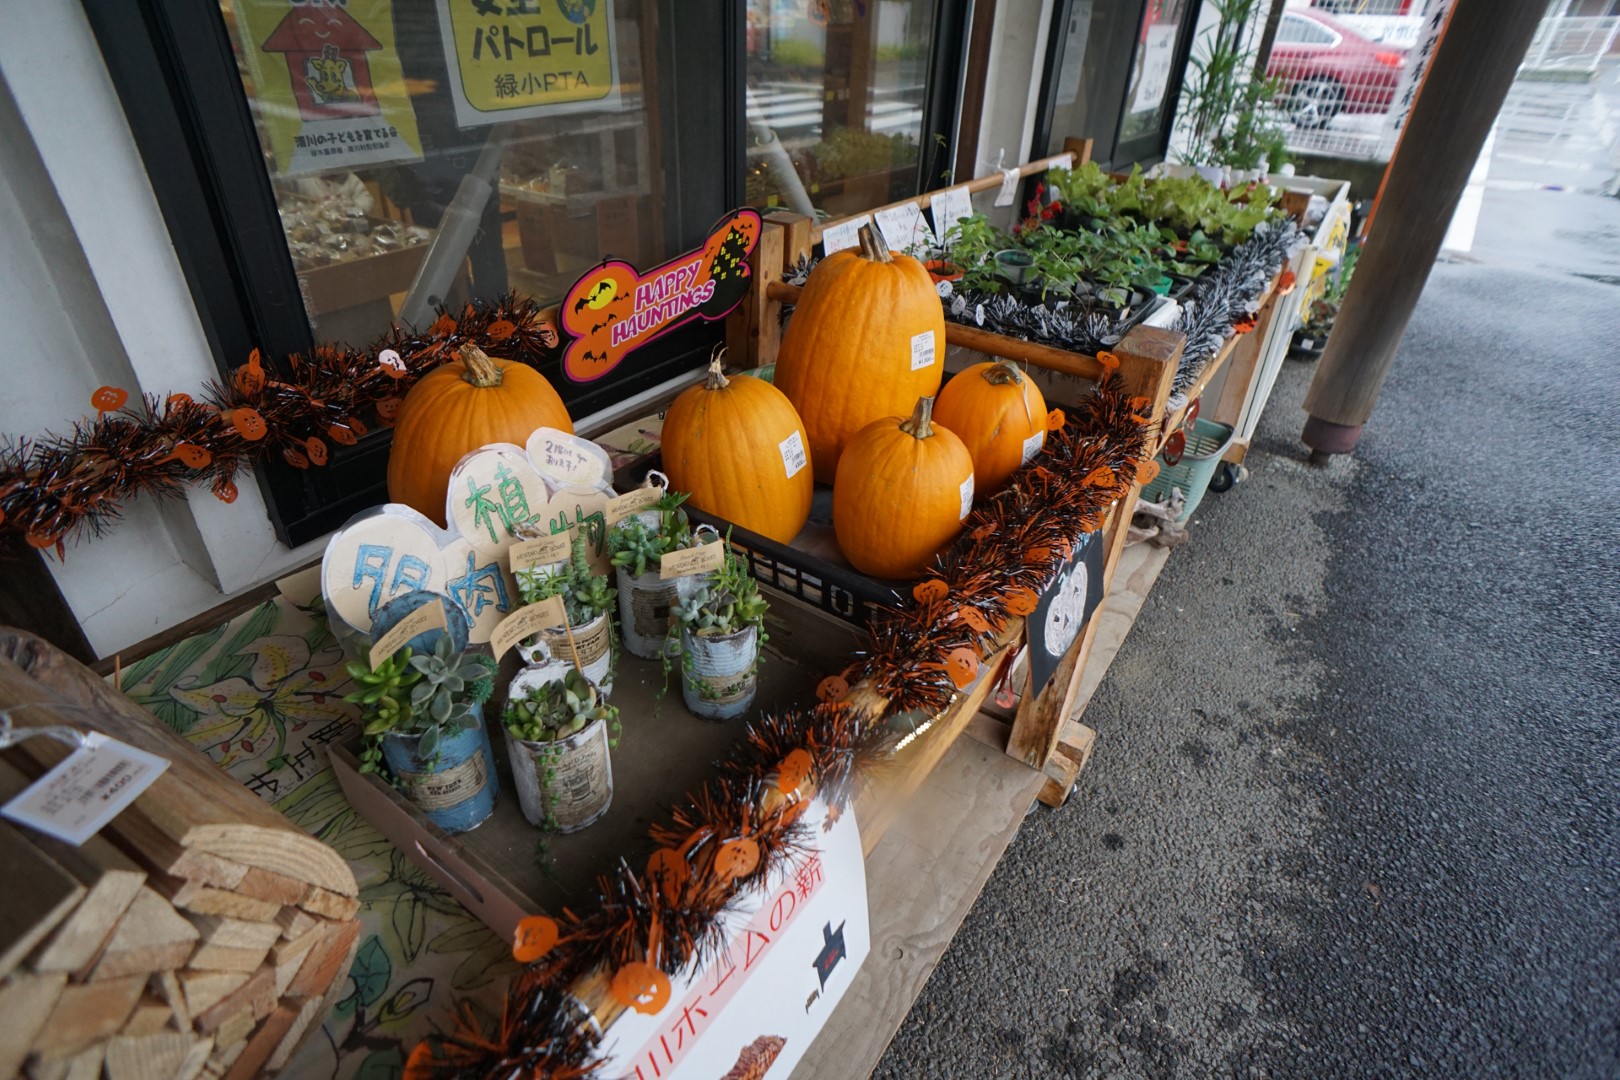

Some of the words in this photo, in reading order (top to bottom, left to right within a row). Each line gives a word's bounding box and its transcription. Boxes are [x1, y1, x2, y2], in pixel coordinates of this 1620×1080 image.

[472, 24, 599, 61] パトロール
[495, 70, 590, 99] 緑小PTA
[634, 259, 702, 313] HAPPY
[611, 279, 716, 348] HAUNTINGS
